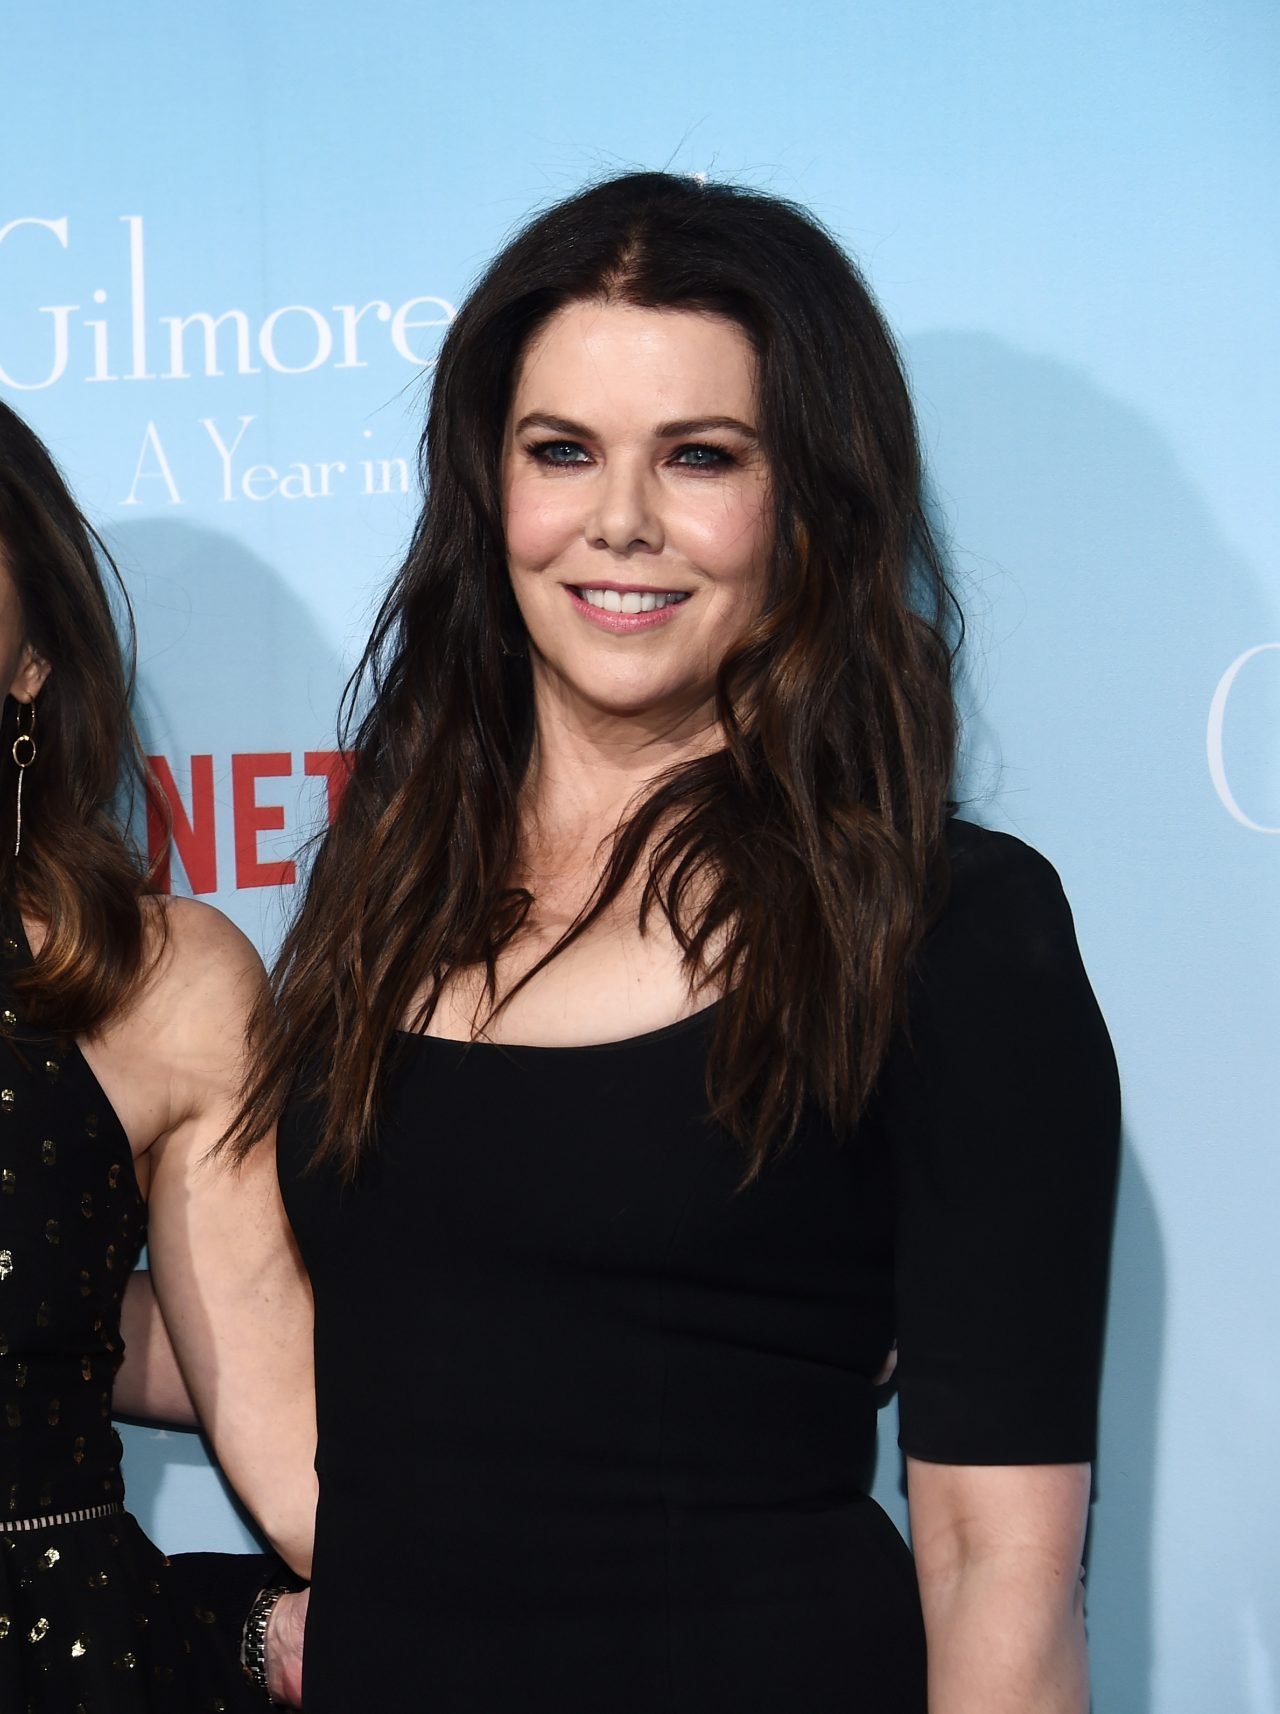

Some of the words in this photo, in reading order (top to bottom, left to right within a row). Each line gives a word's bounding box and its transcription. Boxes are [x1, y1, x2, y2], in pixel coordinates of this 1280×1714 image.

[119, 419, 185, 506] A
[197, 415, 348, 502] Year
[359, 430, 411, 496] in
